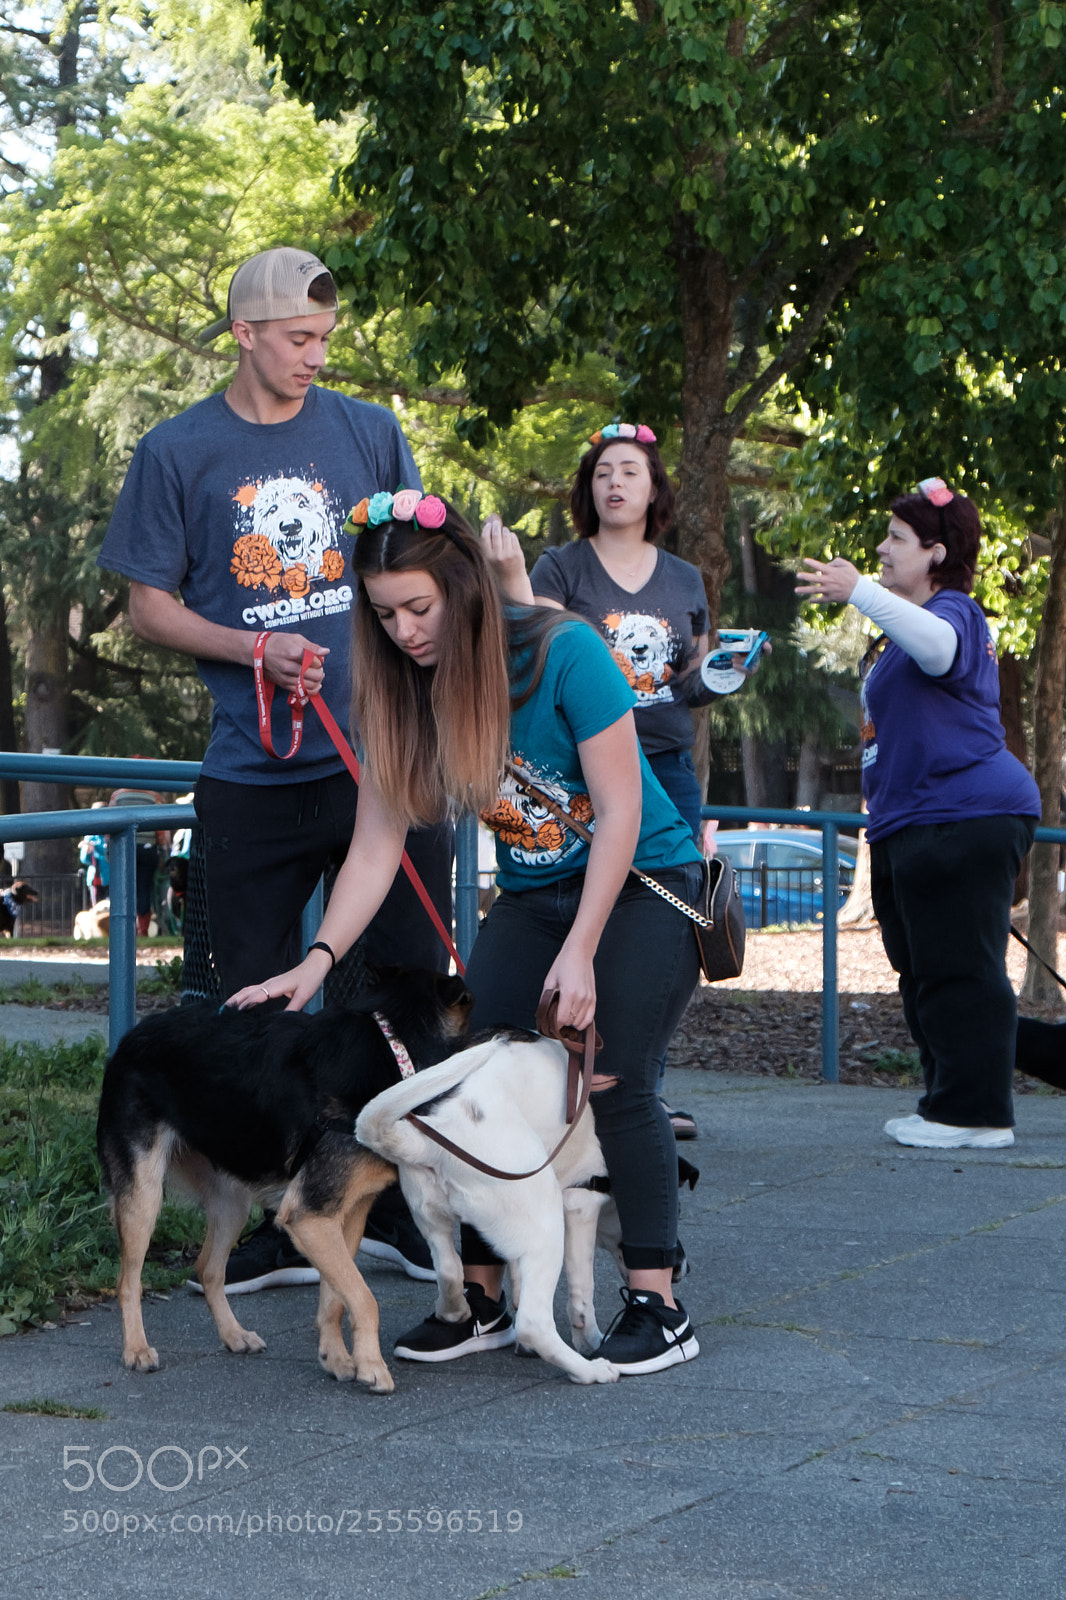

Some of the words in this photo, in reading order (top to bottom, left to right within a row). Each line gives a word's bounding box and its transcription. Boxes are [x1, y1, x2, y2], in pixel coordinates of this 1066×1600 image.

[242, 585, 353, 624] CWOB.ORG
[264, 614, 300, 628] COMPASSION
[300, 608, 324, 621] WITHOUT
[324, 602, 350, 615] BORDERS
